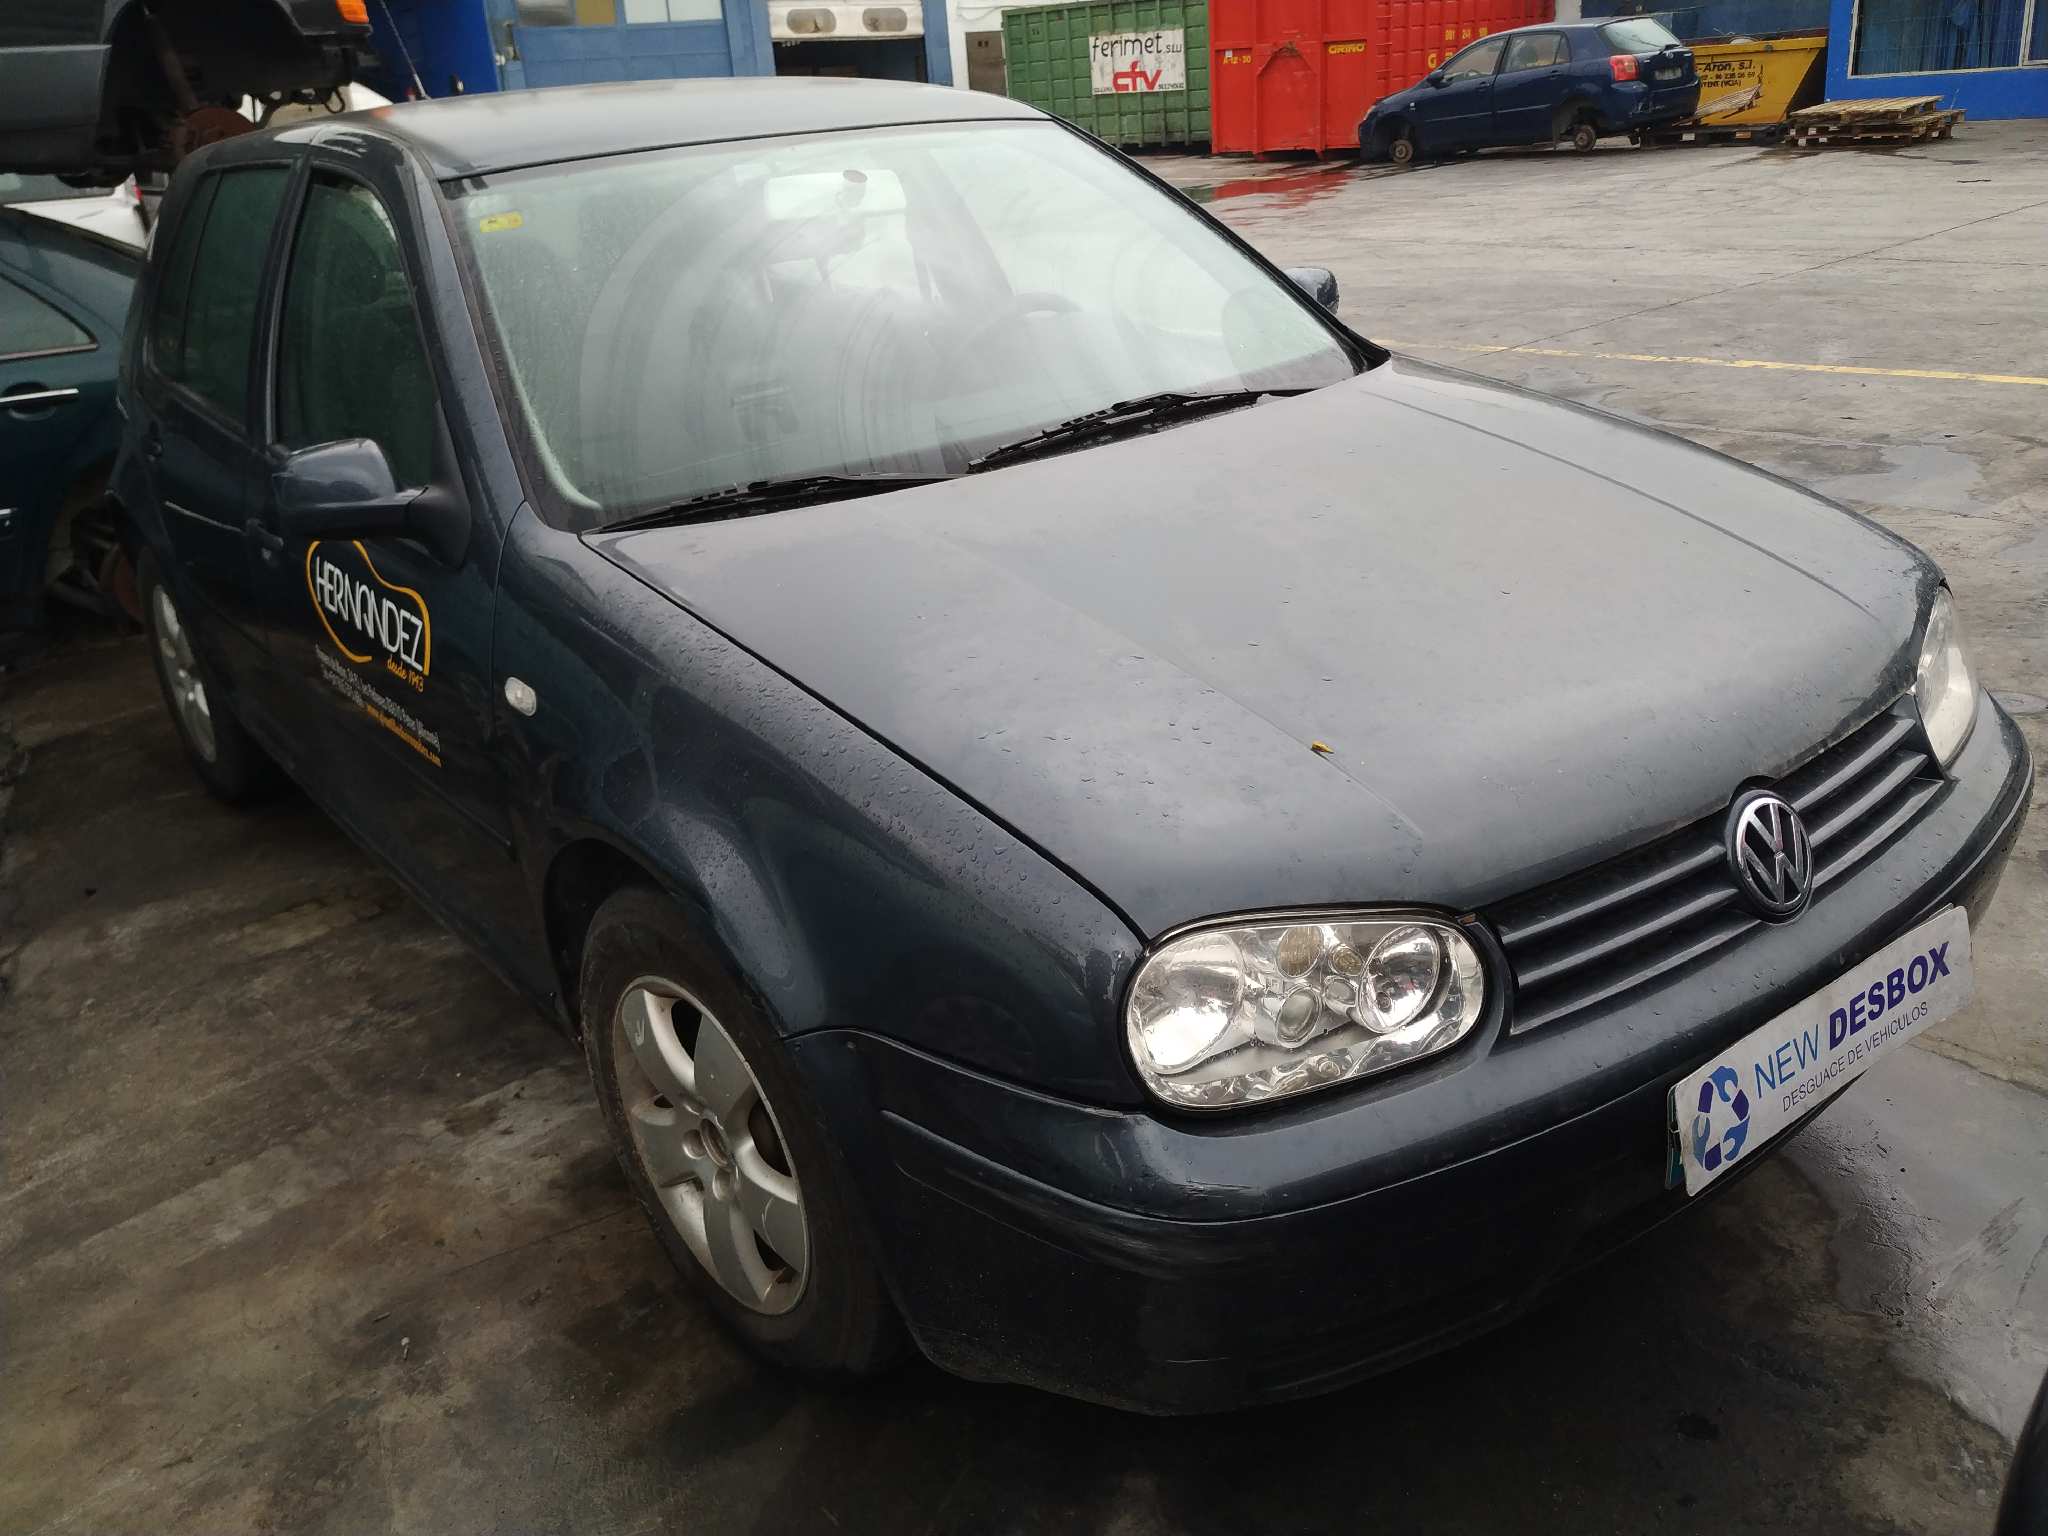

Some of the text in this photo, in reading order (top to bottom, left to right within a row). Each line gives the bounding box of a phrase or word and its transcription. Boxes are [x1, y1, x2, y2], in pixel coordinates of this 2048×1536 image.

[1092, 32, 1162, 62] ferimet
[1754, 940, 1951, 1099] NEW DESBOX
[1782, 1001, 1929, 1113] DESGUACE DE VEHICULOS
